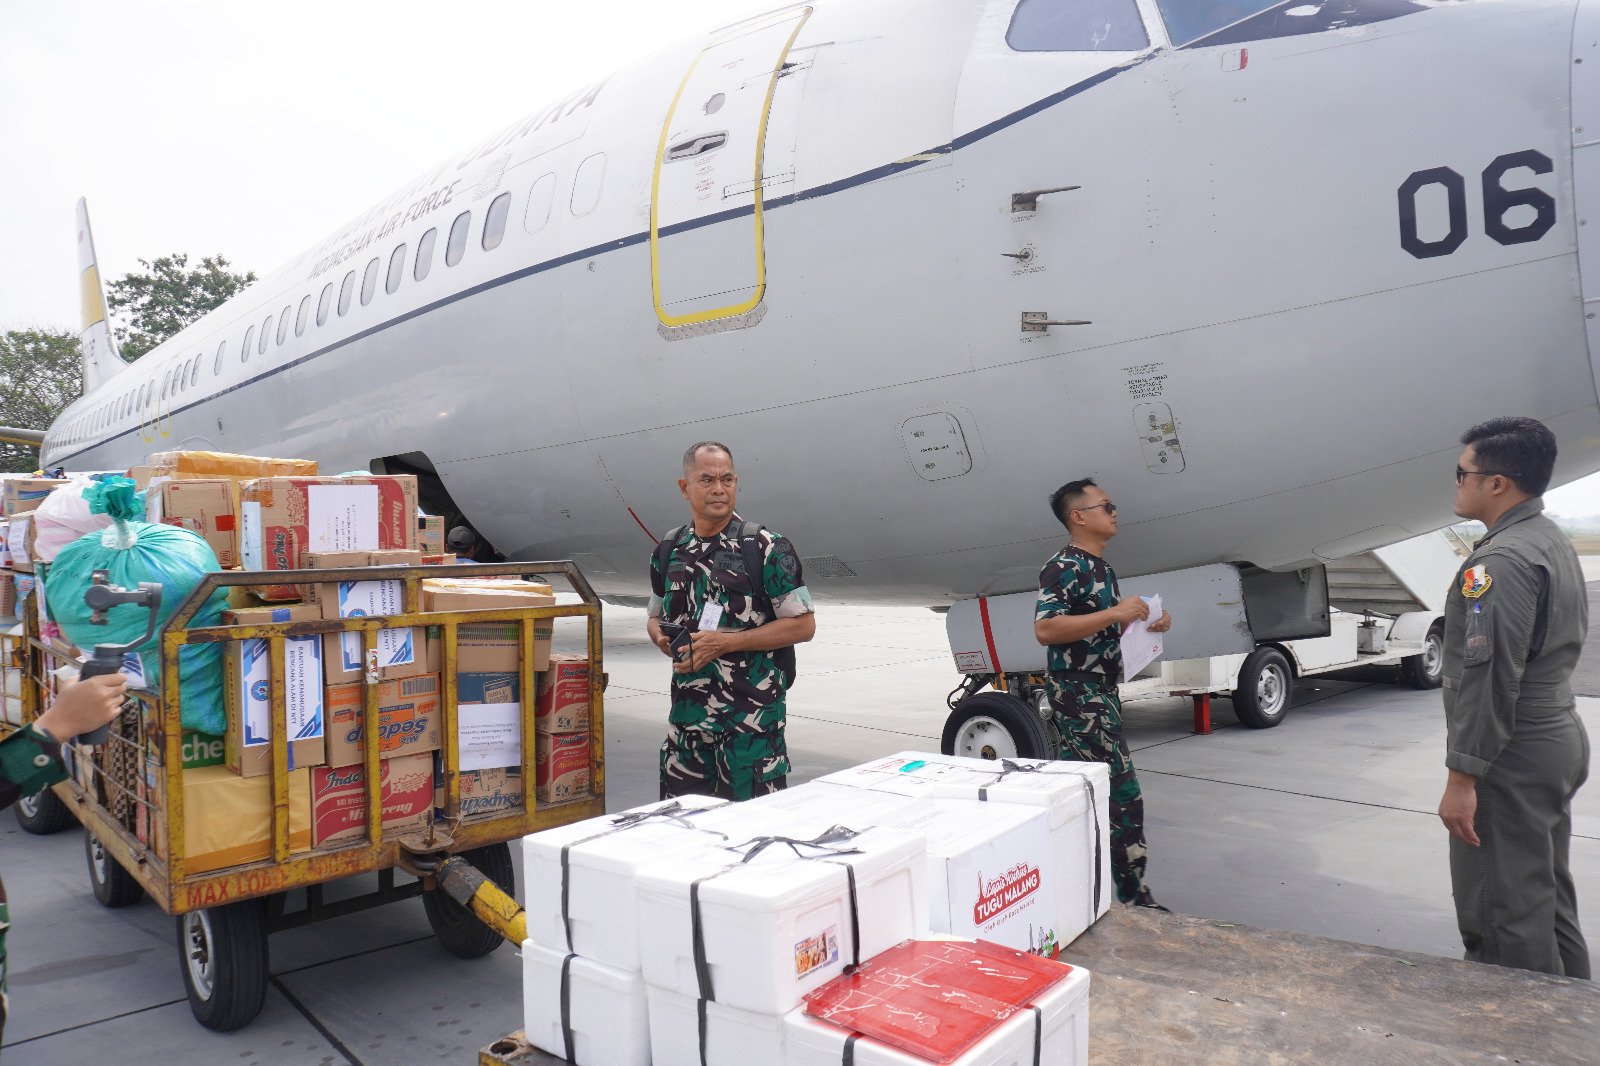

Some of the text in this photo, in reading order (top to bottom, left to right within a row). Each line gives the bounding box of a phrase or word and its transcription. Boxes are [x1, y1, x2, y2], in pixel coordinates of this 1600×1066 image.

[374, 211, 403, 243] AIR
[401, 178, 462, 228] FORCE
[1398, 149, 1556, 260] 06
[228, 661, 236, 733] ENERGEN
[291, 704, 297, 712] DI
[182, 735, 224, 761] che
[187, 867, 285, 908] MAX LOAD
[977, 873, 1039, 920] TUGU MALANG
